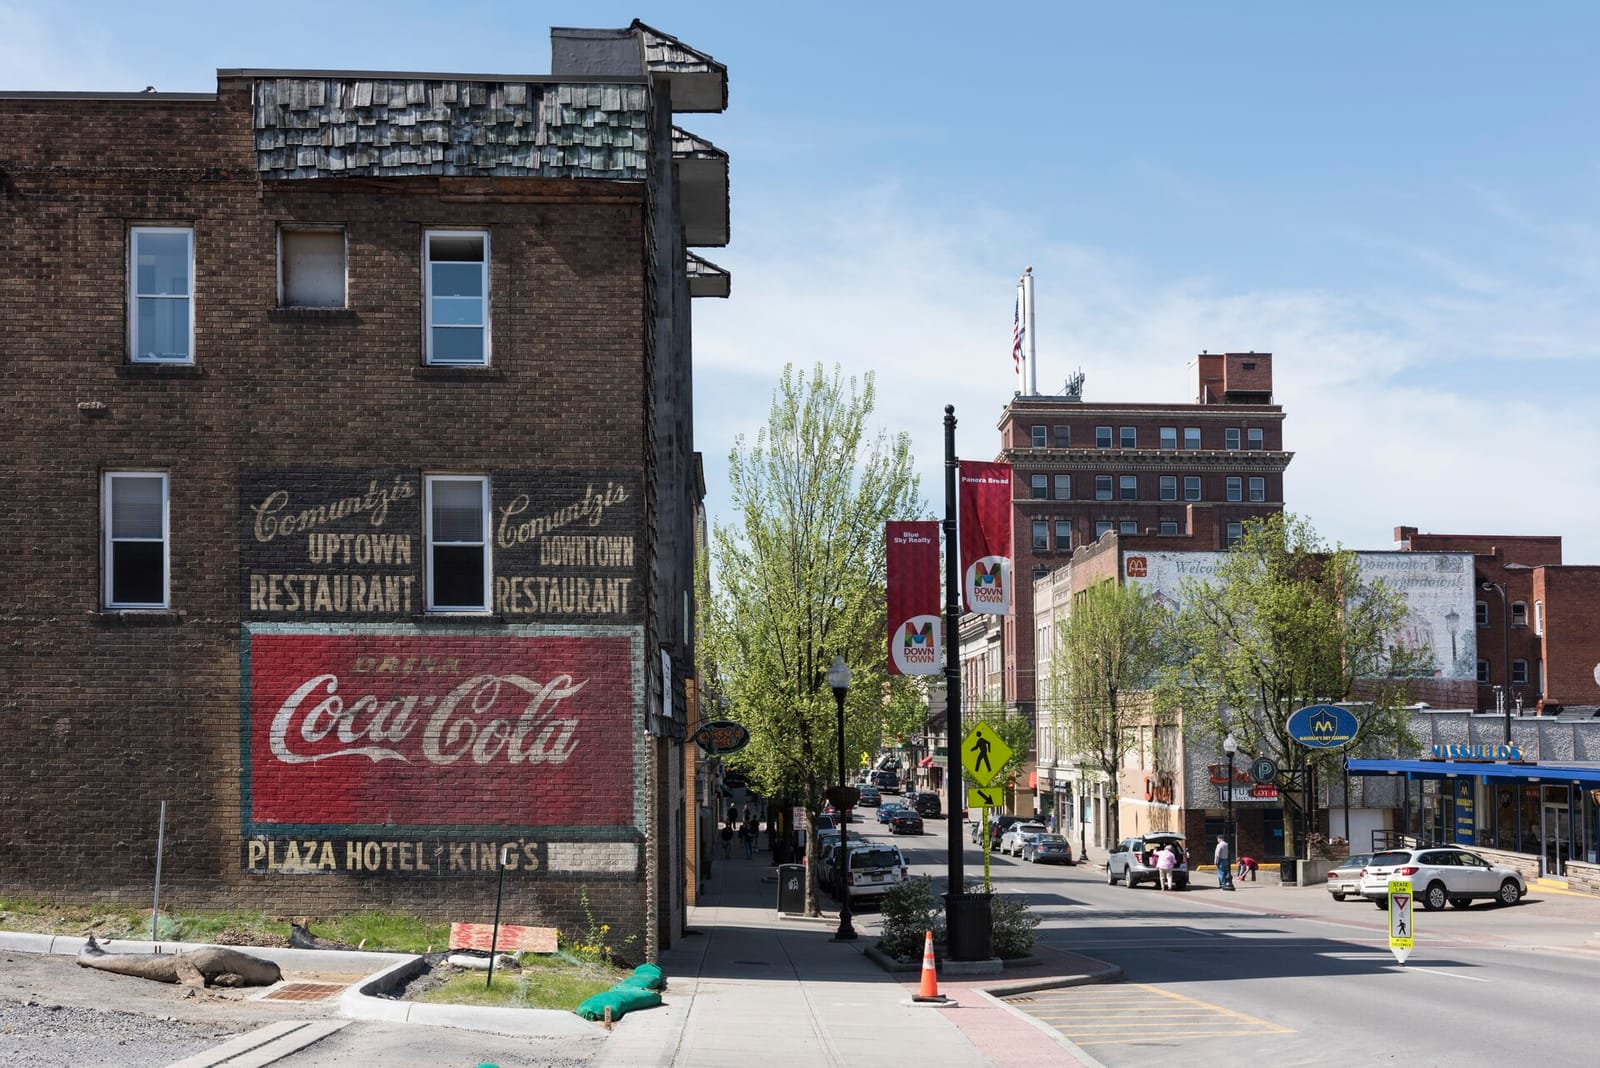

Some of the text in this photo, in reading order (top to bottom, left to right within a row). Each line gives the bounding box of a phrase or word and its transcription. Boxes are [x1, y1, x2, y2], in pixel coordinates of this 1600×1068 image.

[308, 533, 412, 565] UPTOWN
[540, 535, 634, 567] DOWNTOWN
[250, 574, 416, 613] RESTAURANT
[496, 575, 632, 614] RESTAURANT
[974, 587, 1003, 596] DOWN
[975, 595, 1003, 604] TOWN
[904, 647, 934, 656] DOWN
[905, 655, 934, 664] TOWN
[269, 673, 590, 765] Coca-Cola
[1431, 741, 1523, 760] MASSULLO'S
[1253, 789, 1268, 797] LOT
[248, 838, 540, 872] PLAZA HOTEL KING'S
